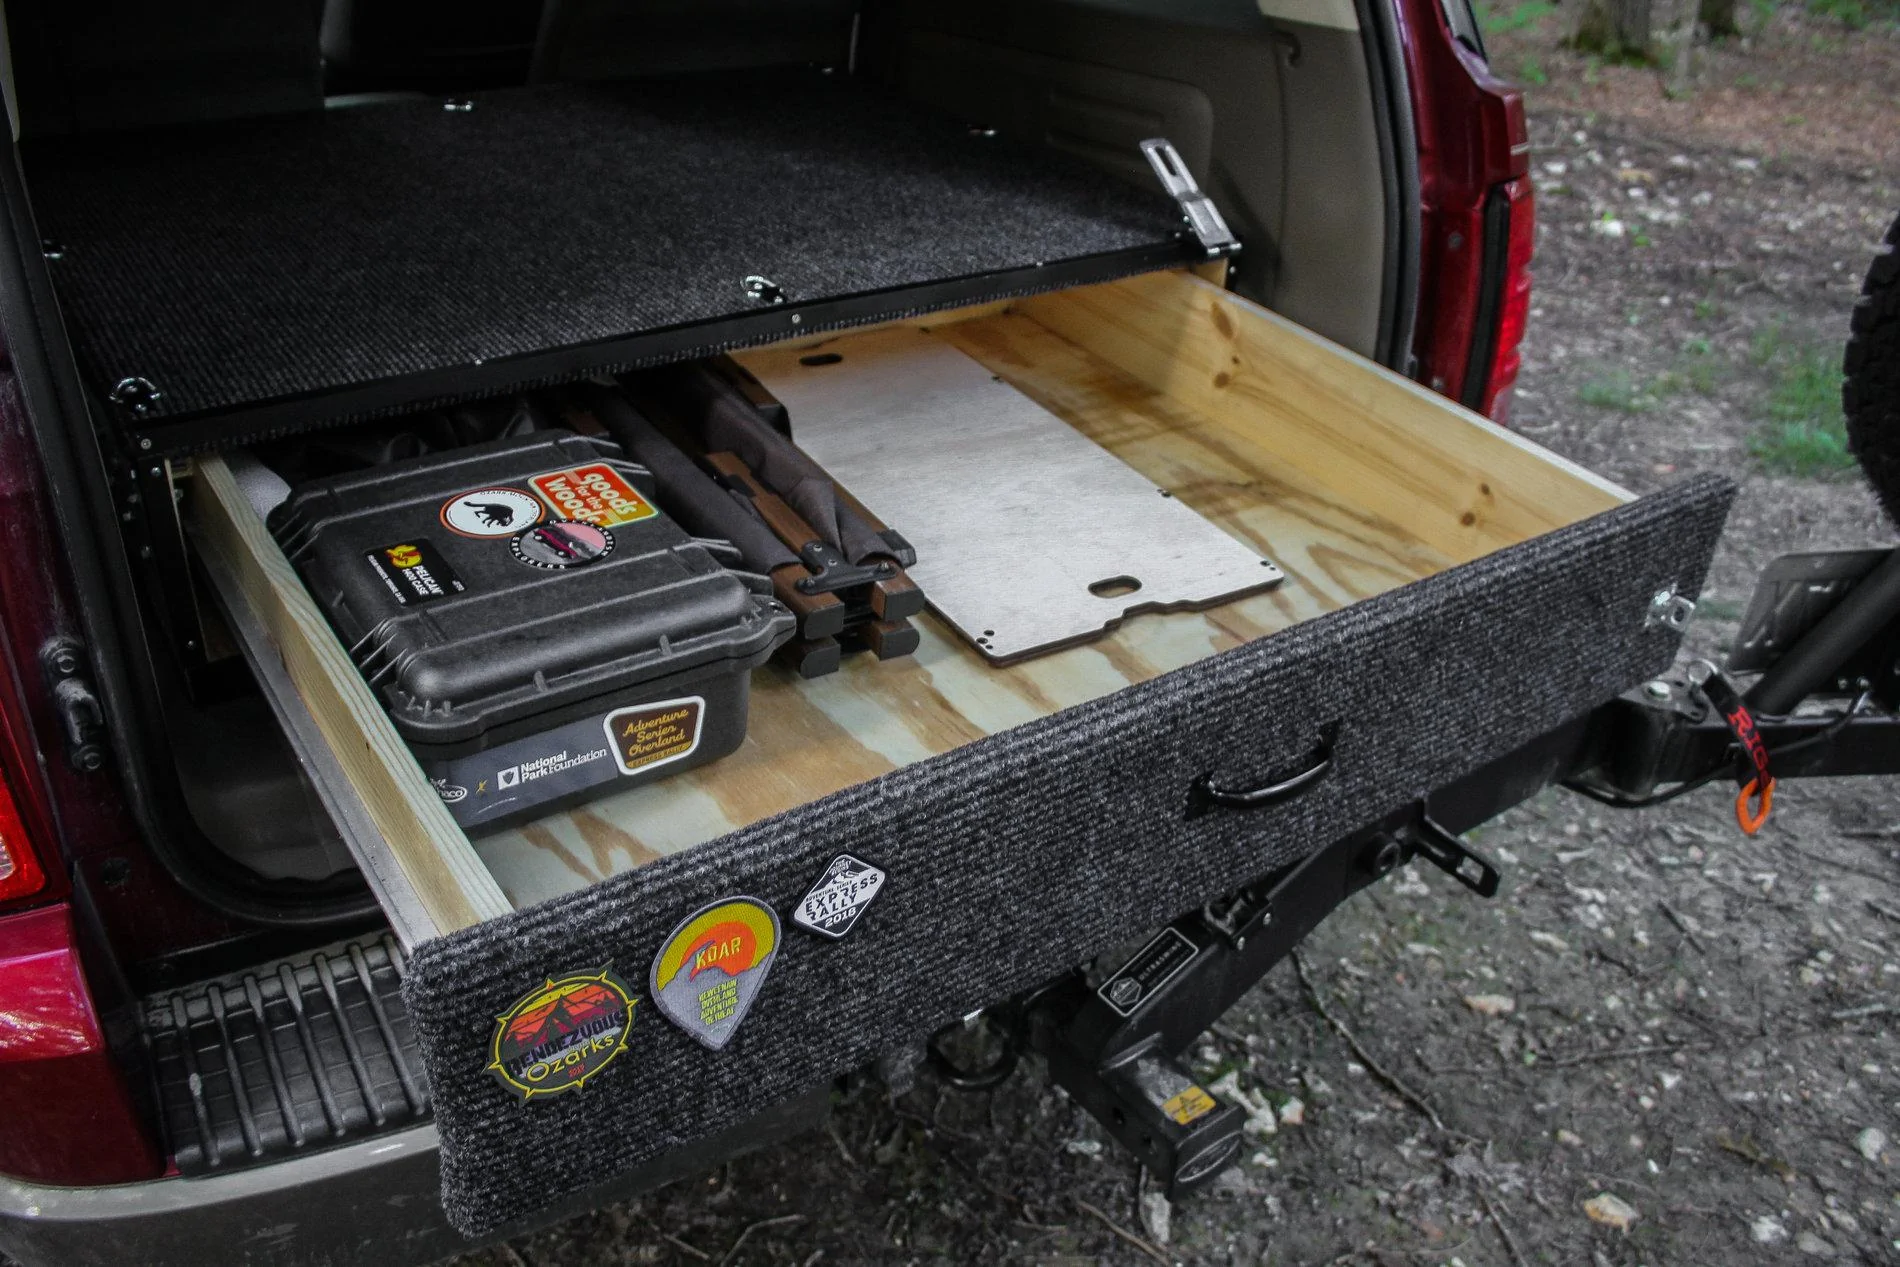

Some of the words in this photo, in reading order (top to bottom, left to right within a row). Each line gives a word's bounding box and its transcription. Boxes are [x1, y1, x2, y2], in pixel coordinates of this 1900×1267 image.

[575, 484, 592, 497] for
[586, 496, 604, 510] the
[580, 473, 638, 516] goods
[411, 580, 430, 596] CASE
[412, 564, 442, 595] PELICAN
[622, 709, 689, 738] Adventure
[637, 724, 676, 743] Series
[628, 728, 686, 757] Overland
[520, 750, 567, 773] National
[521, 768, 547, 783] Park
[548, 748, 607, 775] Foundation
[805, 872, 878, 914] EXPRESS
[806, 892, 858, 921] RALLY
[824, 906, 857, 929] 2018
[696, 936, 742, 969] KOAR
[526, 1034, 615, 1083] Ozarks
